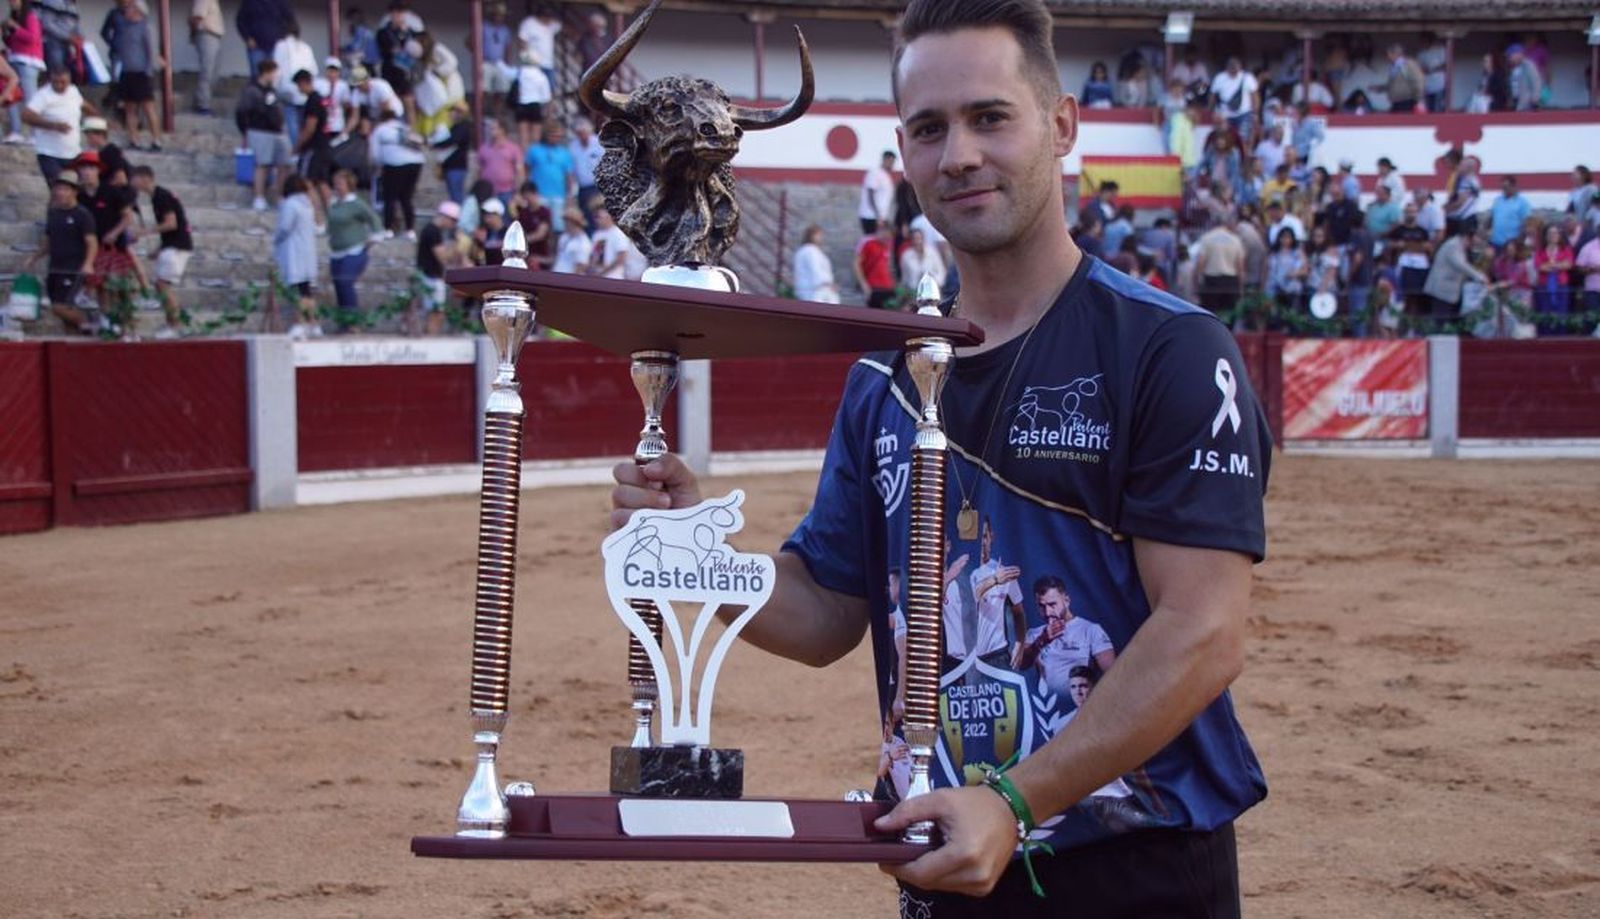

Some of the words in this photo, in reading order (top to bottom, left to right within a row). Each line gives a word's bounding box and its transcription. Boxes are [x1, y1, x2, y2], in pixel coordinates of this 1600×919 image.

[1072, 416, 1111, 435] Talent
[1016, 447, 1031, 458] 10
[1034, 450, 1100, 463] ANIVERSARIO
[1189, 449, 1254, 477] J.S.M.
[711, 556, 766, 574] Talento
[624, 563, 763, 592] Castellano
[949, 700, 970, 719] DE
